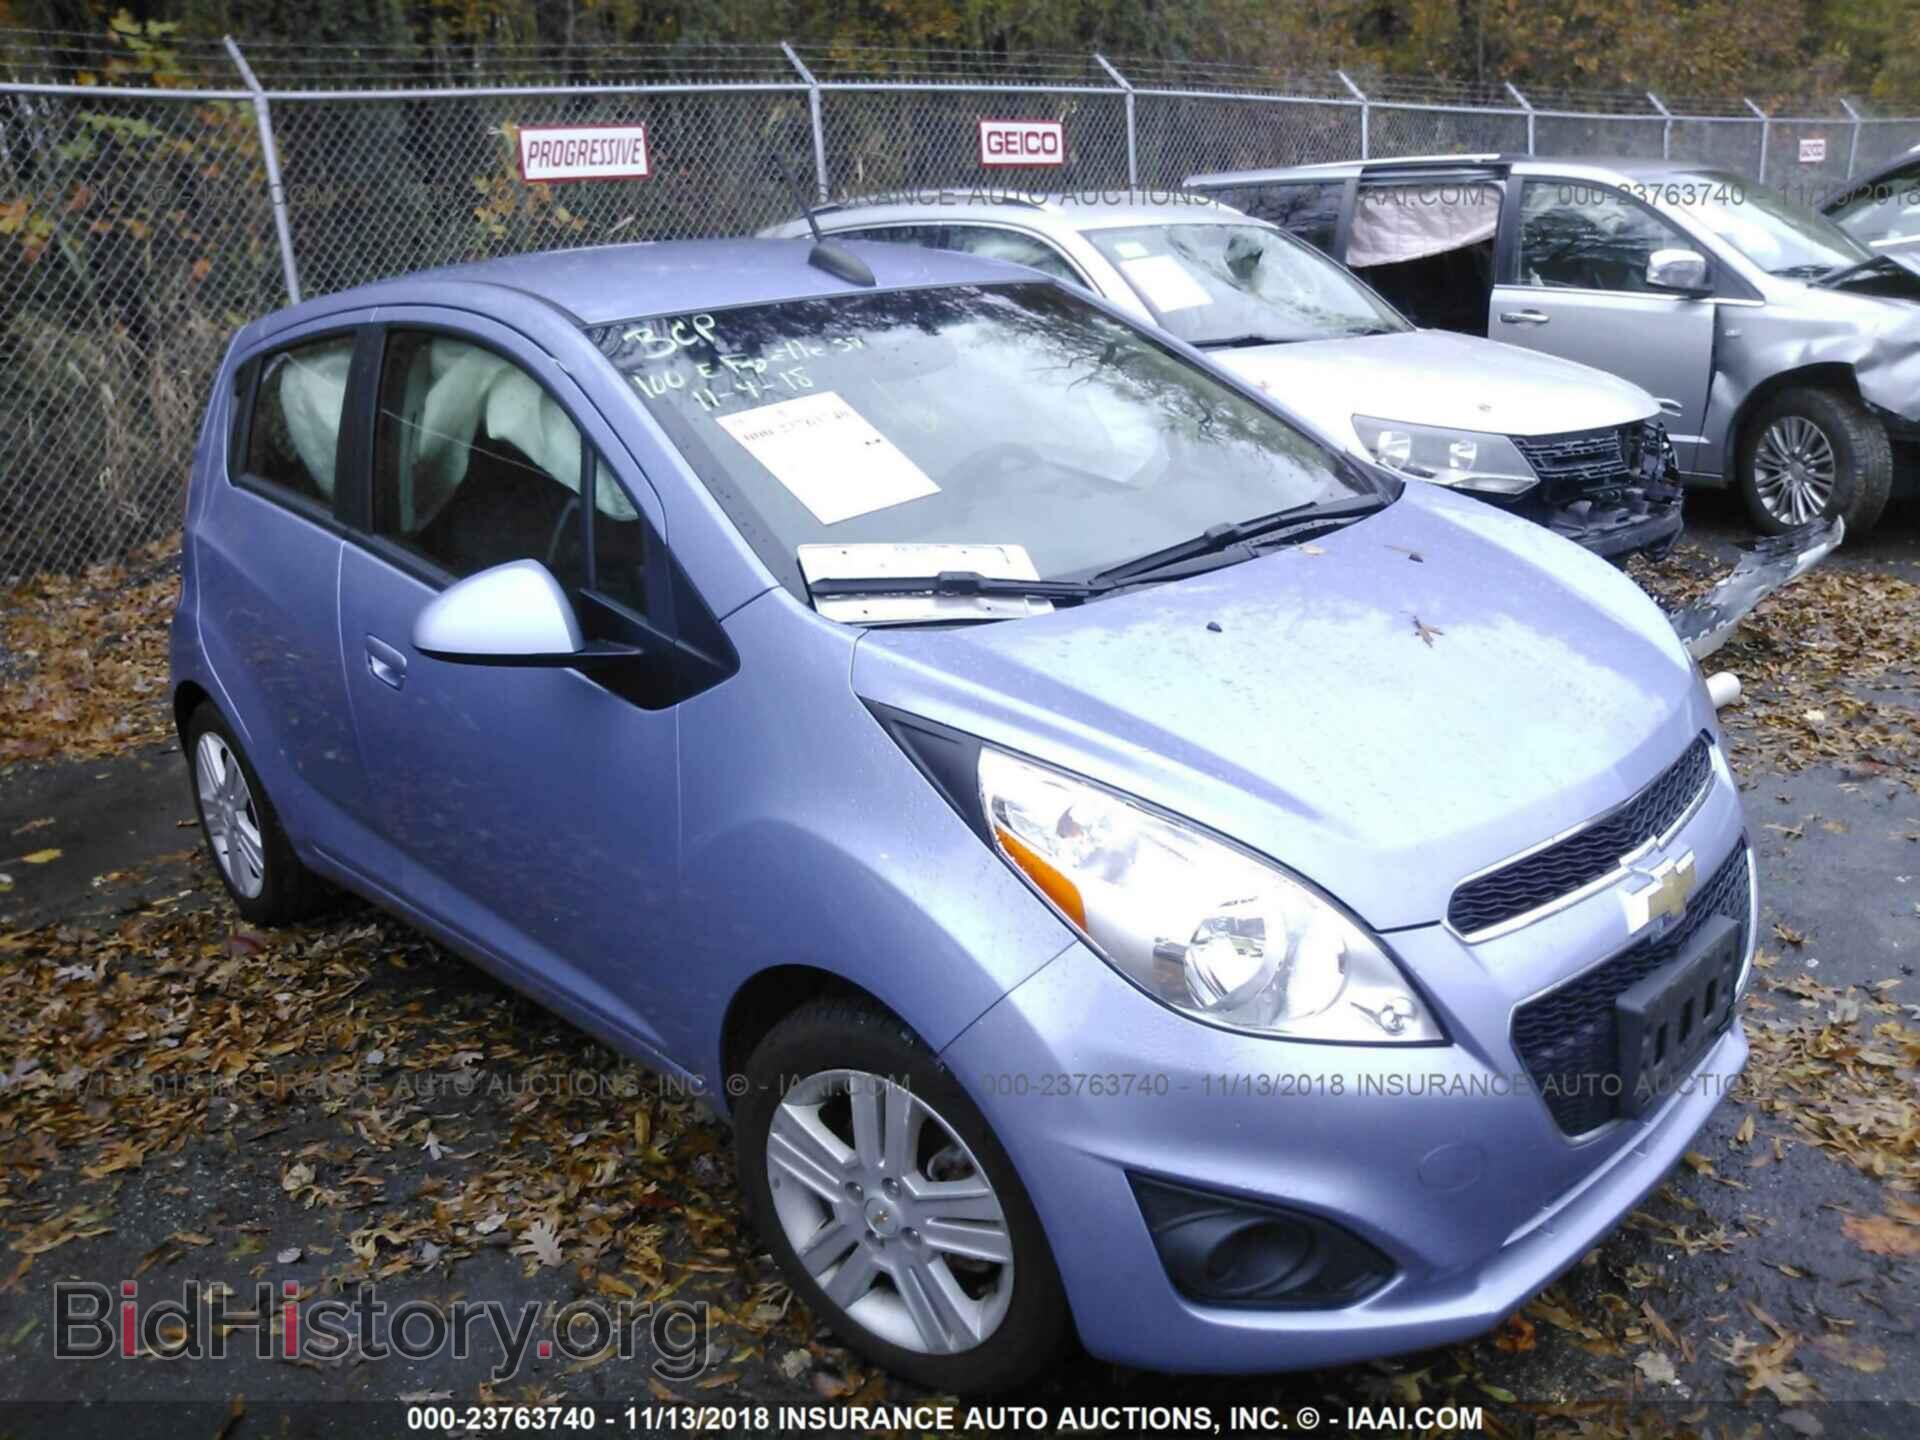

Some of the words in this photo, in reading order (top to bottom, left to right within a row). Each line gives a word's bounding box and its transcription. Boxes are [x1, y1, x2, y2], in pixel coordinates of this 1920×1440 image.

[527, 138, 642, 168] PROGRESSIVE
[987, 131, 1058, 155] GEICO
[623, 313, 715, 359] BCP
[633, 370, 686, 400] 100
